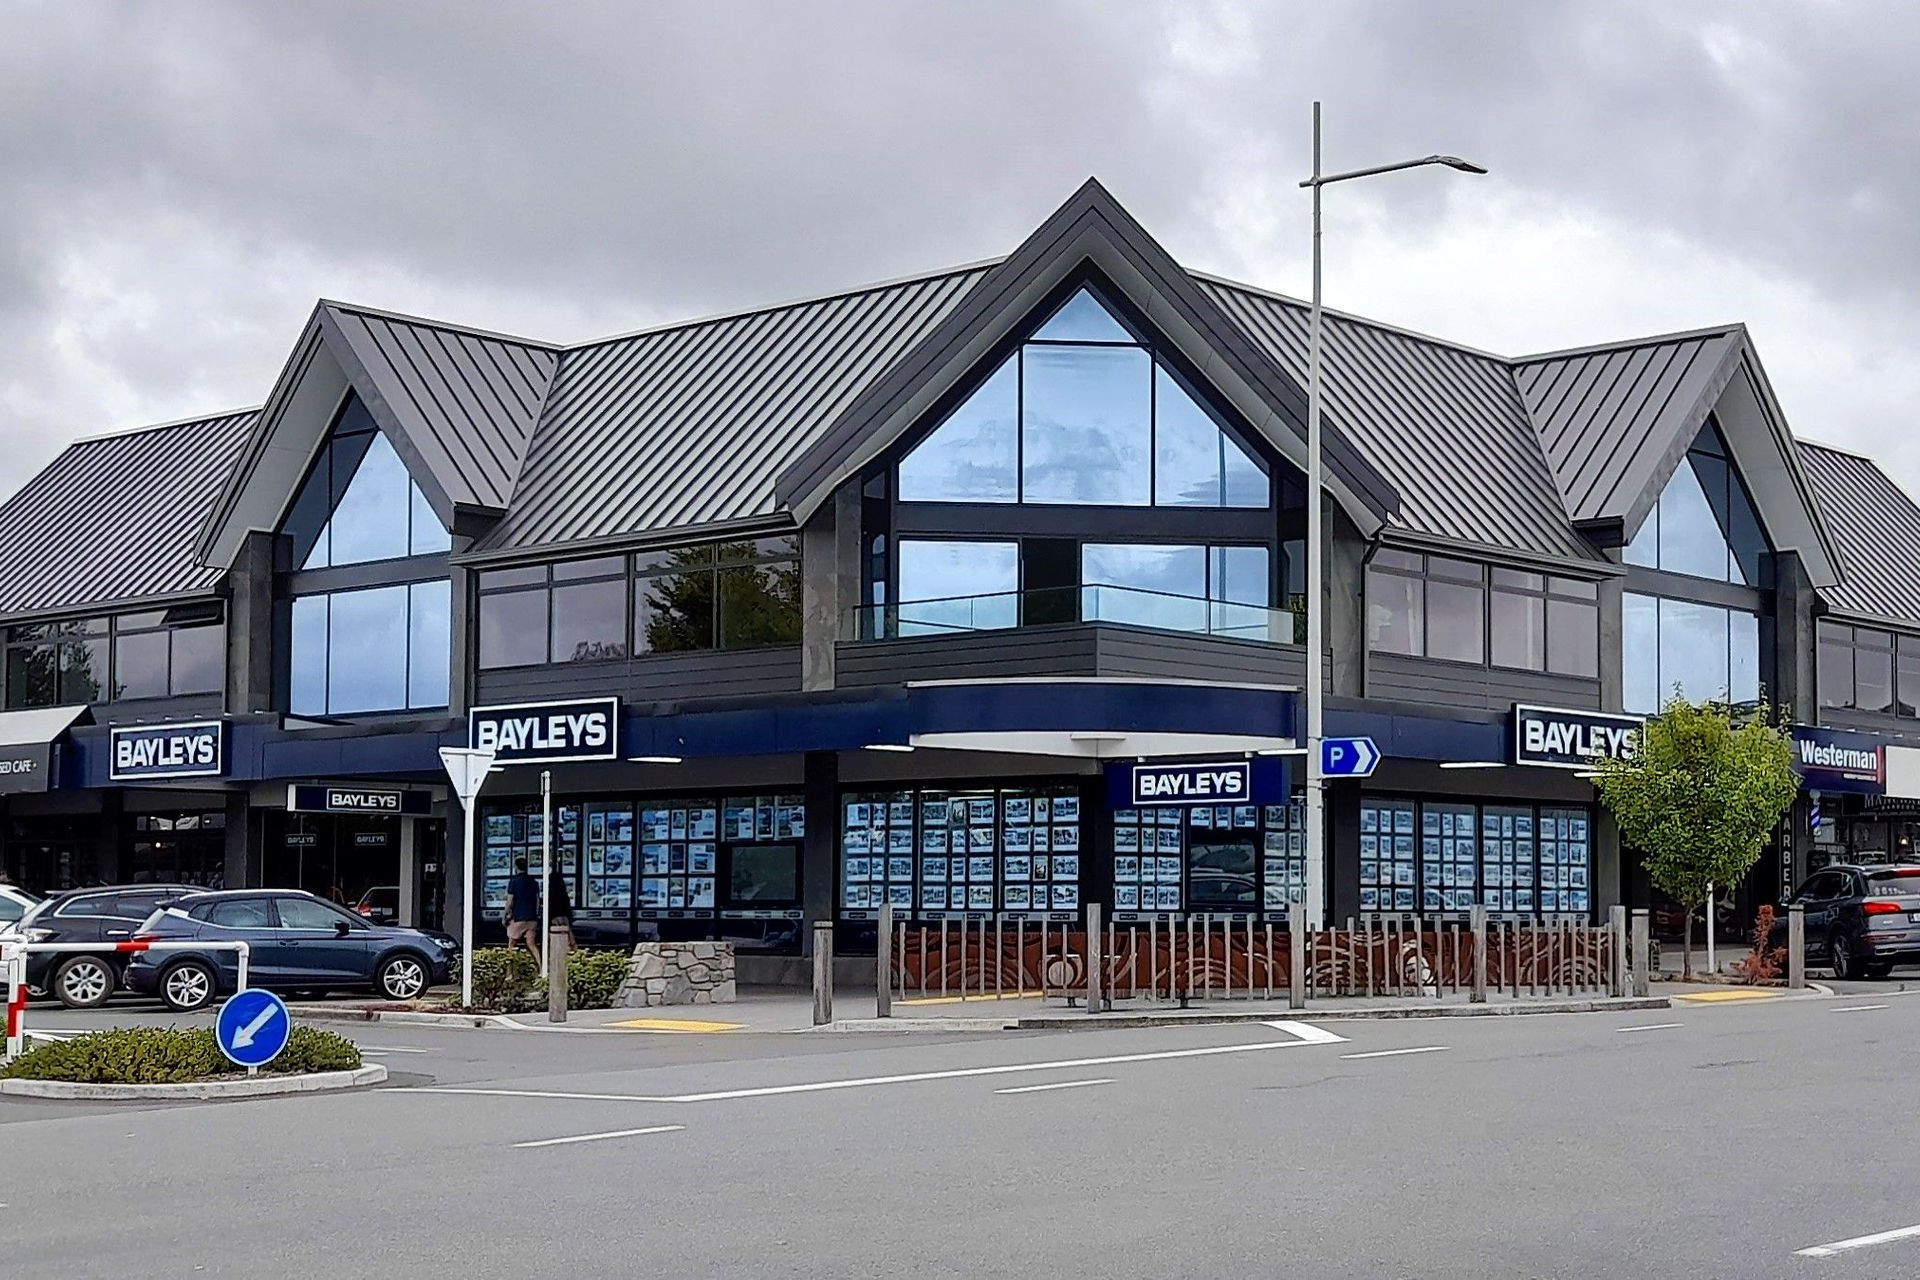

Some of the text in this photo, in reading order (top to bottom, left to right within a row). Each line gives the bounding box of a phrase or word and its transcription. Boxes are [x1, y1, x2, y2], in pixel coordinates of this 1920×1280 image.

[478, 712, 606, 750] BAYLEYS
[1525, 719, 1637, 760] BAYLEYS
[117, 734, 213, 768] BAYLEYS
[1330, 747, 1343, 768] P
[1800, 740, 1877, 770] Westerman
[12, 759, 31, 773] CAFE
[1140, 771, 1242, 796] BAYLEYS
[331, 793, 397, 808] BAYLEYS
[356, 835, 385, 844] BAYLEYS
